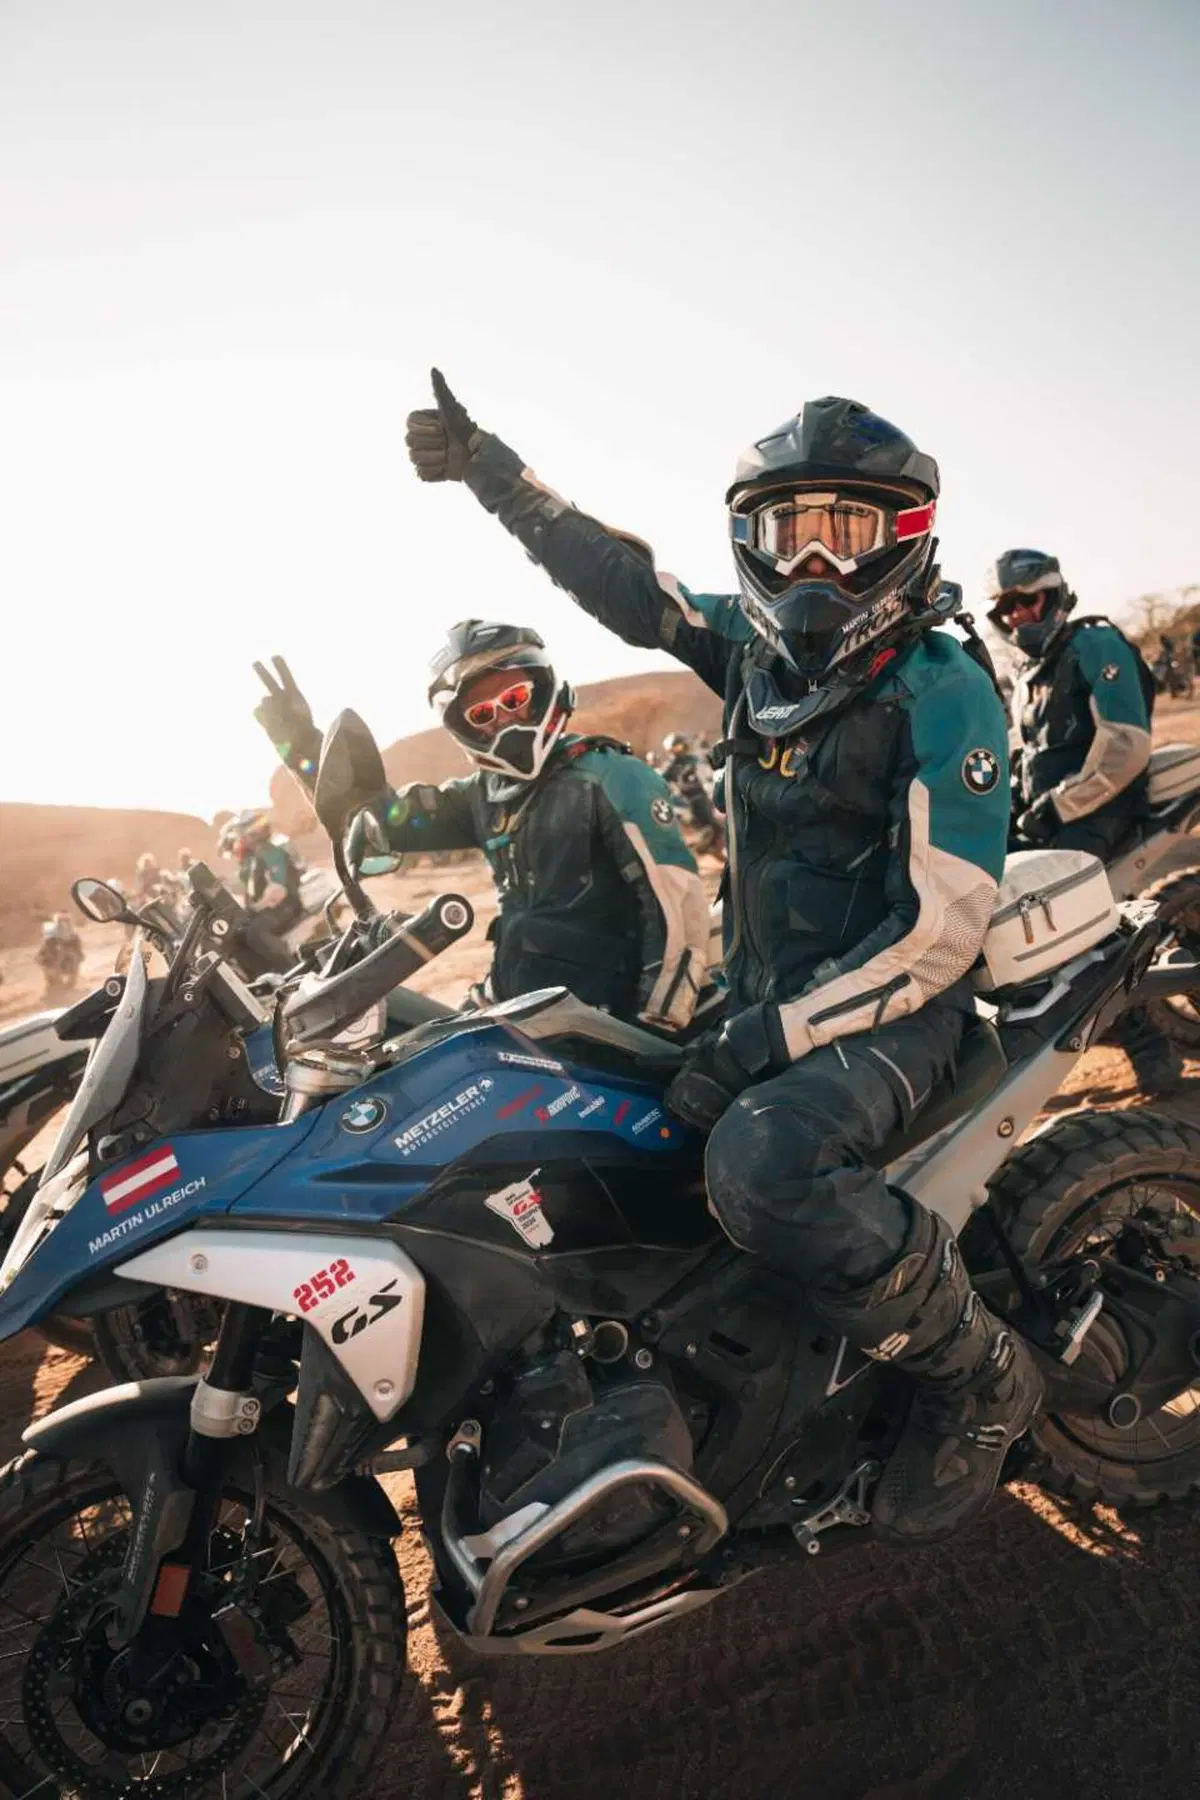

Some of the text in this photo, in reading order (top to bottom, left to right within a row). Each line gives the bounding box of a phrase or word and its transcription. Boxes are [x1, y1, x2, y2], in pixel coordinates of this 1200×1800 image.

[394, 1085, 480, 1149] METZELER
[402, 1113, 460, 1156] MOTORCYCLE
[88, 1176, 206, 1255] MARTIN ULREICH
[293, 1258, 355, 1312] 252
[331, 1279, 402, 1344] GS
